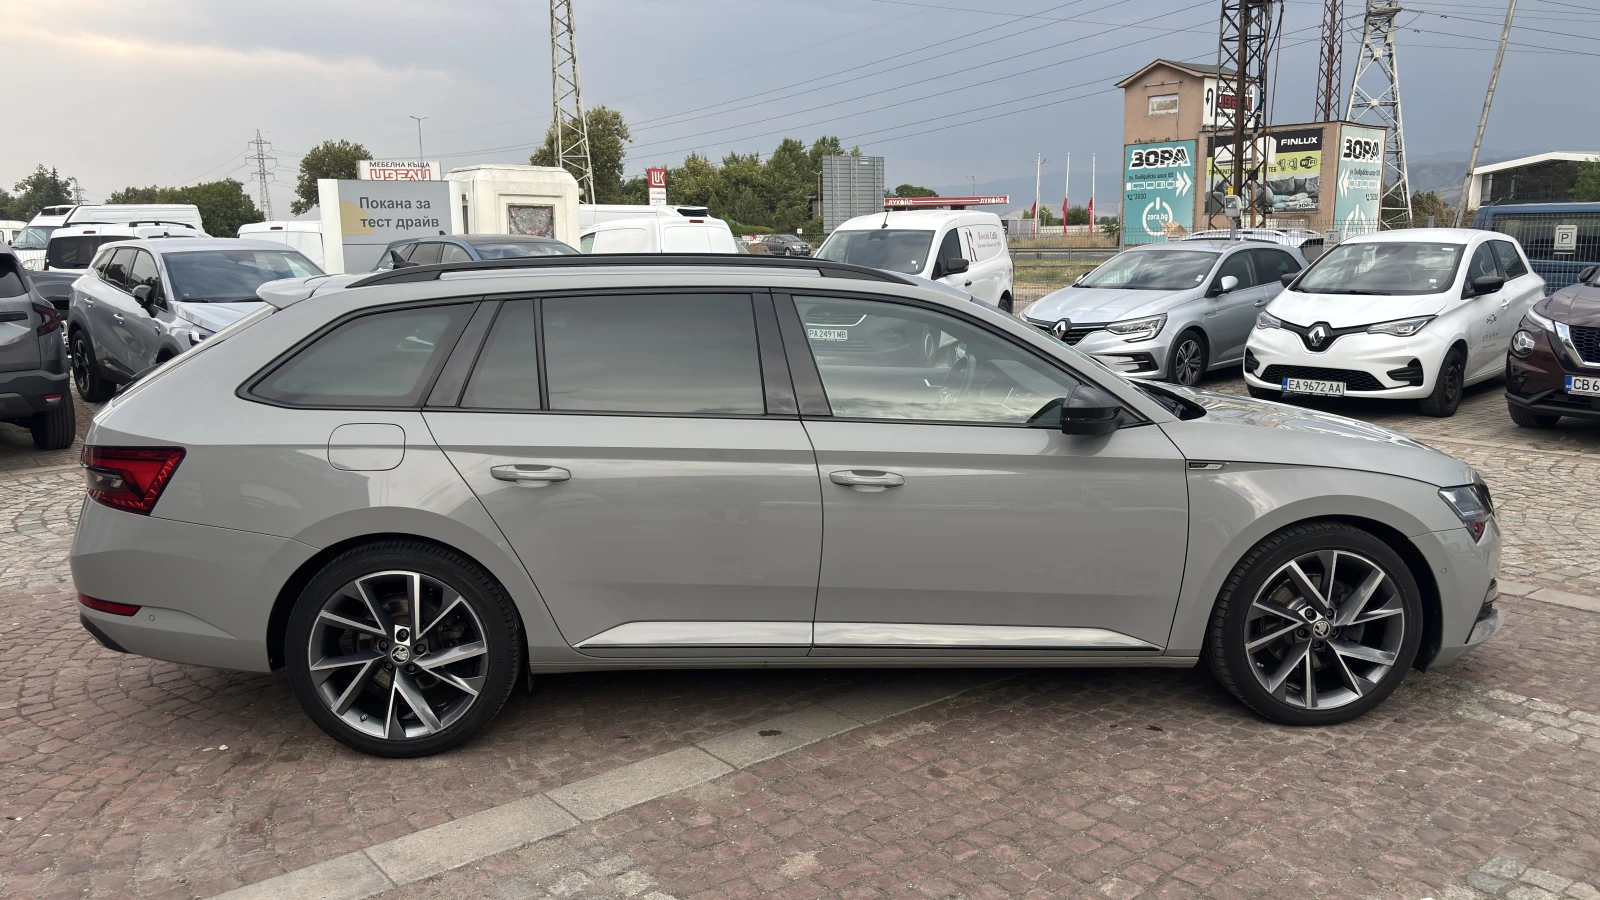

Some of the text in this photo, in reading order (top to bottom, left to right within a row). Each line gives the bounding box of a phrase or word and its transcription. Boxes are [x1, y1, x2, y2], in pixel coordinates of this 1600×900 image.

[1281, 137, 1318, 146] FINLUX
[1342, 137, 1381, 162] ЗОРА
[1129, 147, 1191, 169] ЗОРА
[359, 196, 431, 209] Покана за
[360, 215, 440, 230] тест драйв
[1147, 212, 1169, 222] zora.bg
[1560, 233, 1570, 243] P
[1288, 380, 1301, 390] EA
[1303, 380, 1327, 392] 9672
[1328, 382, 1341, 394] AA
[1573, 378, 1590, 390] CB
